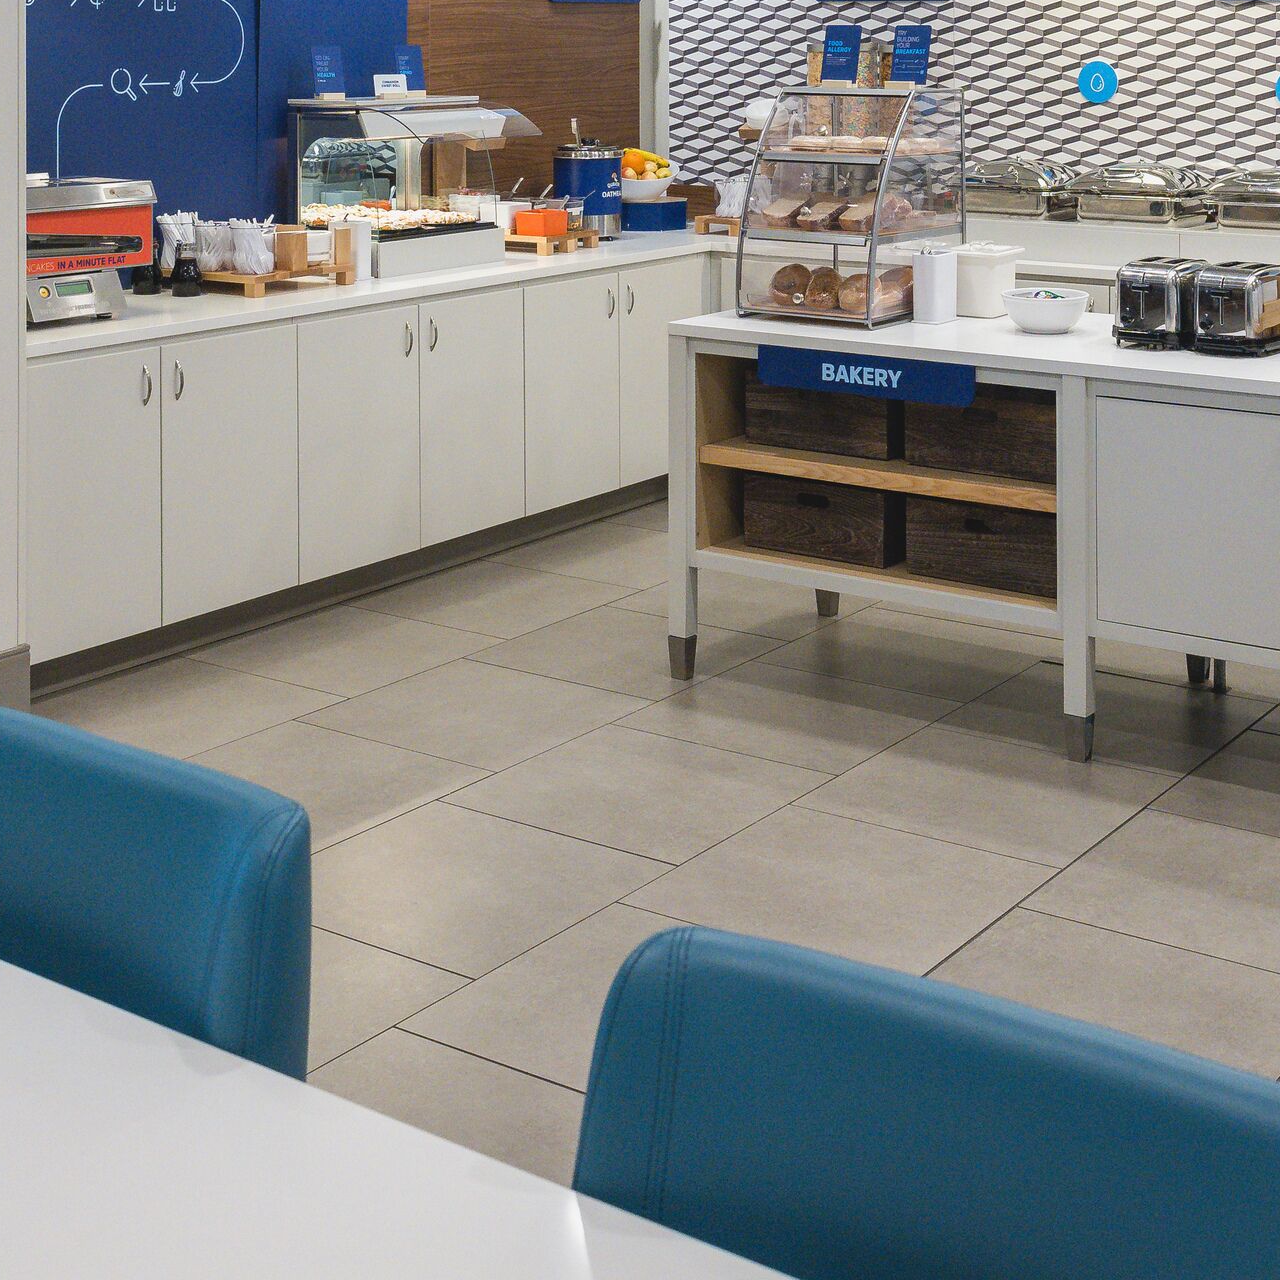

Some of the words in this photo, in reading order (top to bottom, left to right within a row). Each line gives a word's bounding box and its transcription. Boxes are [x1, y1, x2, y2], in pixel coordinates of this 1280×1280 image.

[57, 261, 66, 269] IN
[67, 260, 74, 268] A
[75, 257, 106, 267] MINUTE
[107, 255, 127, 264] FLAT
[821, 362, 902, 389] BAKERY
